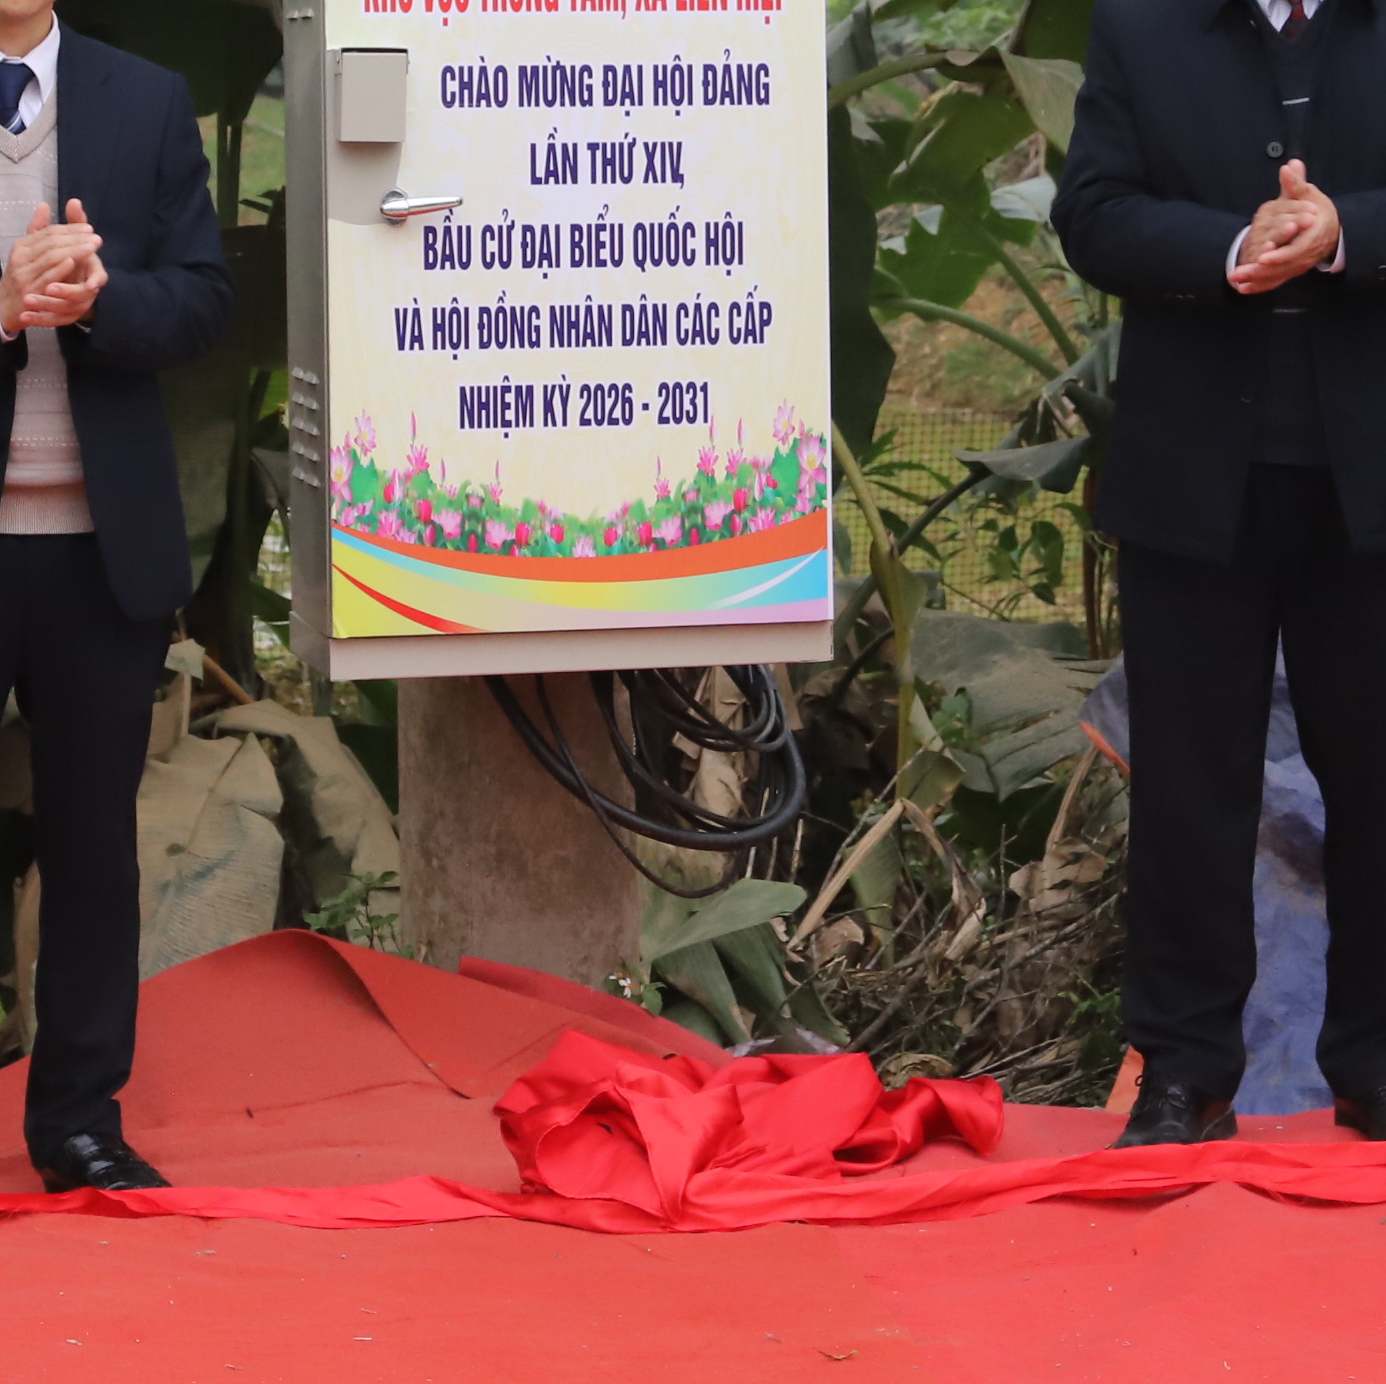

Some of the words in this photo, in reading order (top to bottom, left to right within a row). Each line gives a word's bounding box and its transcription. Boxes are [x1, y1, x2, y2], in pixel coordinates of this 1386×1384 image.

[441, 56, 509, 109] CHÀO
[518, 55, 594, 108] MỪNG
[602, 65, 644, 117] ĐẠI
[653, 55, 694, 117] HỘI
[702, 49, 770, 106] ĐẢNG
[530, 127, 578, 186] LẦN
[587, 133, 637, 185] THỨ
[643, 141, 685, 190] XIV,
[423, 207, 472, 271] BẦU
[481, 208, 516, 271] CỬ
[521, 224, 561, 279] ĐẠI
[570, 204, 624, 269] BIỂU
[633, 205, 696, 273] QUỐC
[705, 211, 744, 277] HỘI
[394, 298, 425, 352] VÀ
[432, 296, 470, 361] HỘI
[478, 290, 541, 350] ĐỒNG
[549, 295, 613, 349] NHÂN
[621, 294, 668, 347] DÂN
[676, 293, 720, 347] CÁC
[728, 285, 773, 345] CẤP
[459, 375, 535, 439] NHIỆM
[543, 374, 572, 428] KỲ
[579, 383, 634, 427] 2026
[641, 402, 650, 411] -
[657, 381, 709, 425] 2031
